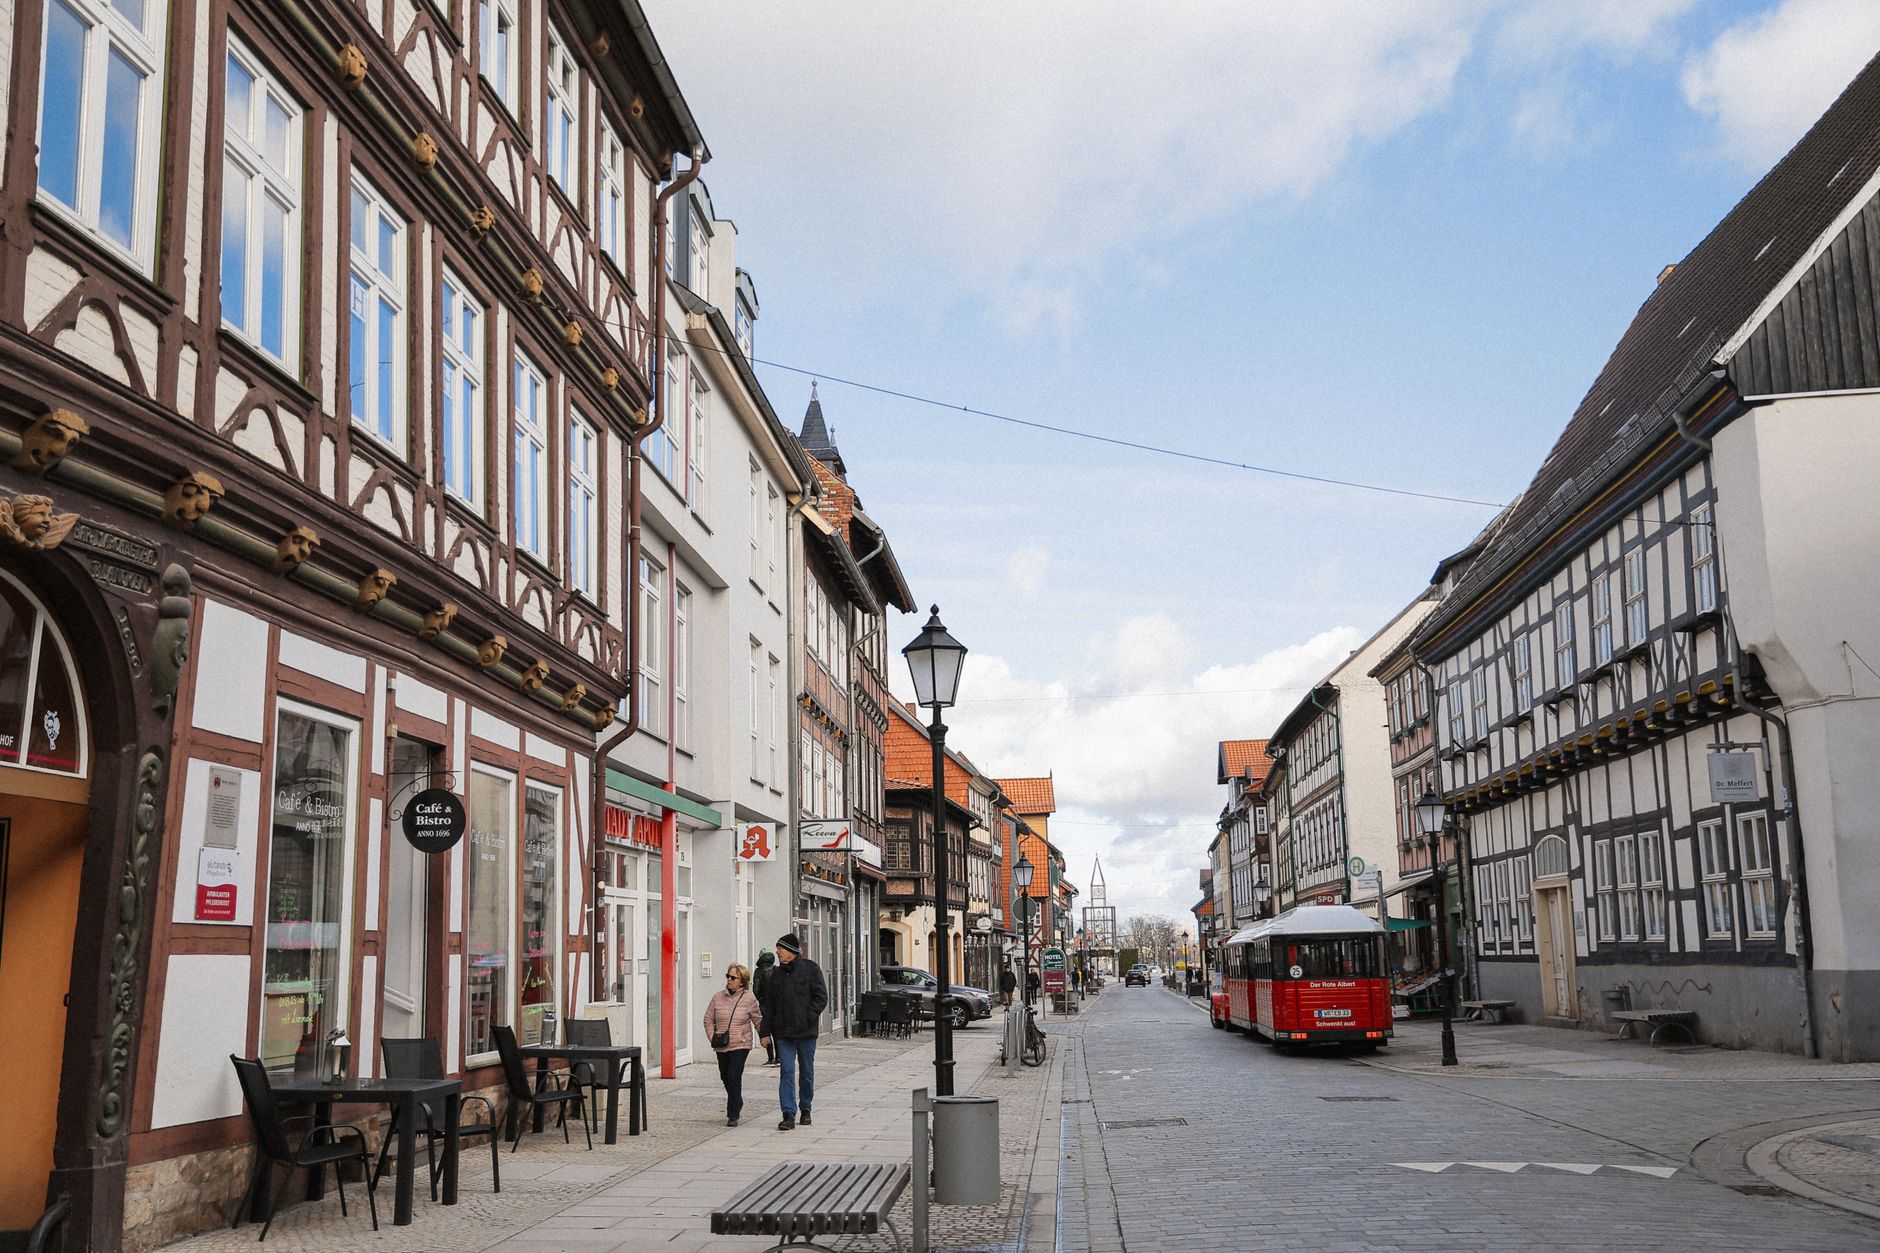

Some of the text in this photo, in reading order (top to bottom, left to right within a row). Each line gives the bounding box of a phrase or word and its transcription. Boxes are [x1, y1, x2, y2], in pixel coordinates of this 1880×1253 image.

[279, 790, 340, 818] Café & Bistro
[416, 803, 442, 813] Café
[416, 816, 452, 825] Bistro
[605, 804, 632, 839] TADT
[436, 829, 450, 837] 1696
[1353, 861, 1360, 873] H
[1317, 895, 1334, 903] SPD
[1292, 967, 1301, 976] 25
